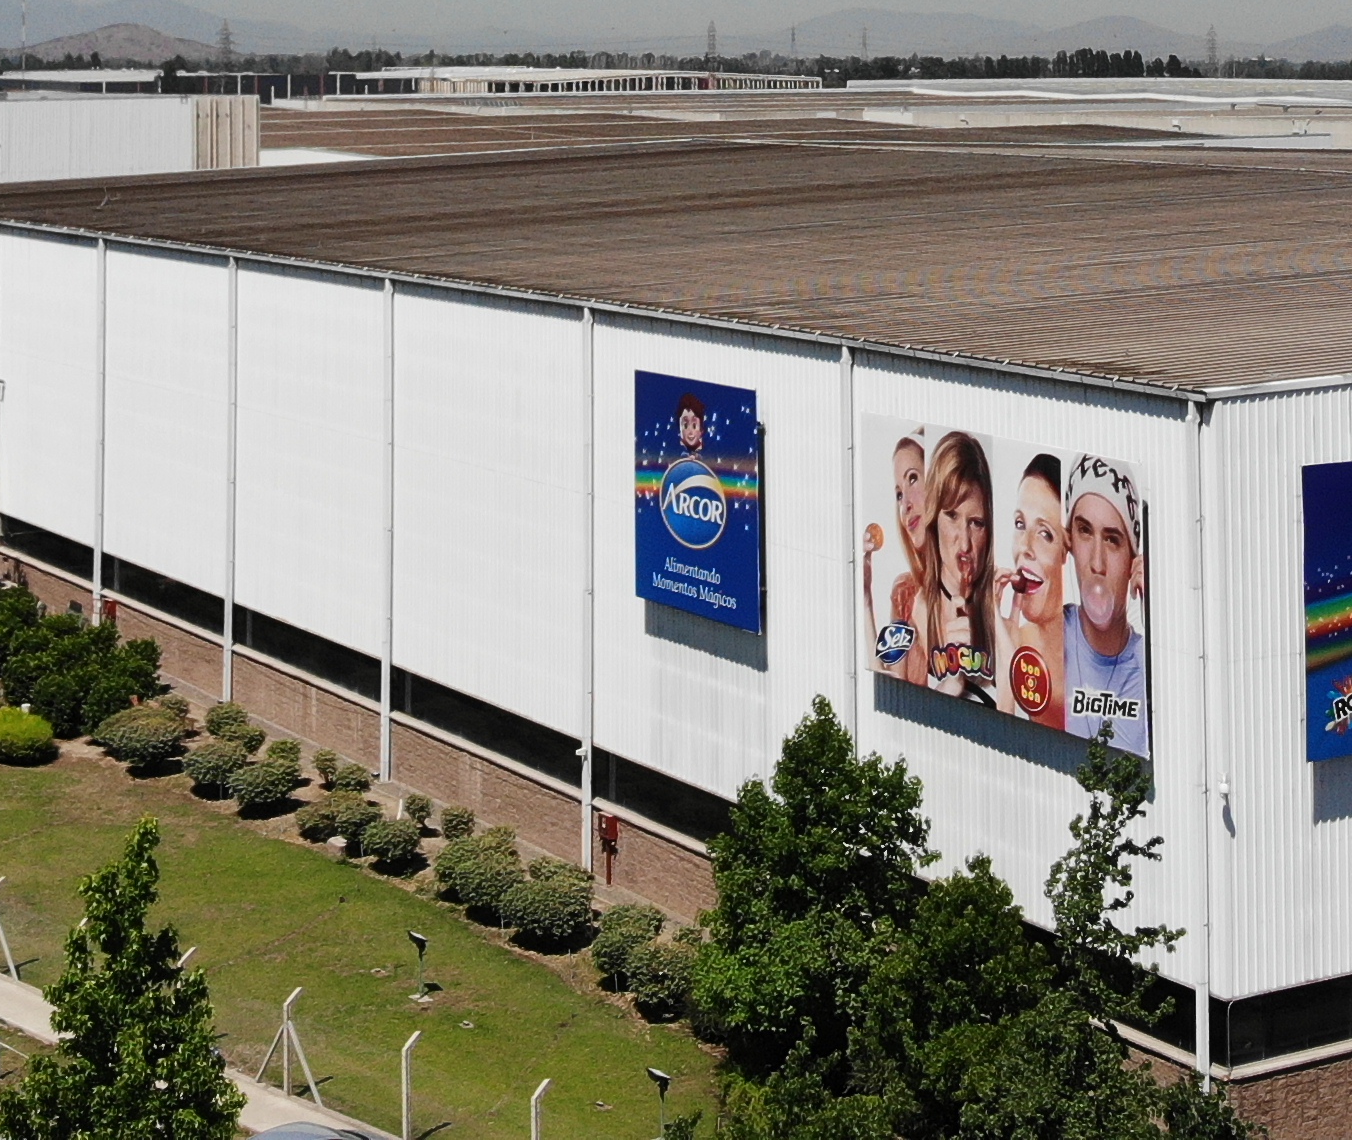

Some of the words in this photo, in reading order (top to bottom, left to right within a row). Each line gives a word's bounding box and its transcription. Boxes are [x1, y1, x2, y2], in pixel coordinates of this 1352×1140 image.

[662, 482, 723, 525] ARCOR
[664, 556, 721, 585] Alimentando
[652, 571, 698, 598] Momentos
[699, 584, 737, 610] Mágicos
[876, 626, 911, 651] Selz
[932, 645, 993, 679] MOGUL
[1020, 658, 1041, 677] bon
[1020, 685, 1041, 703] bon
